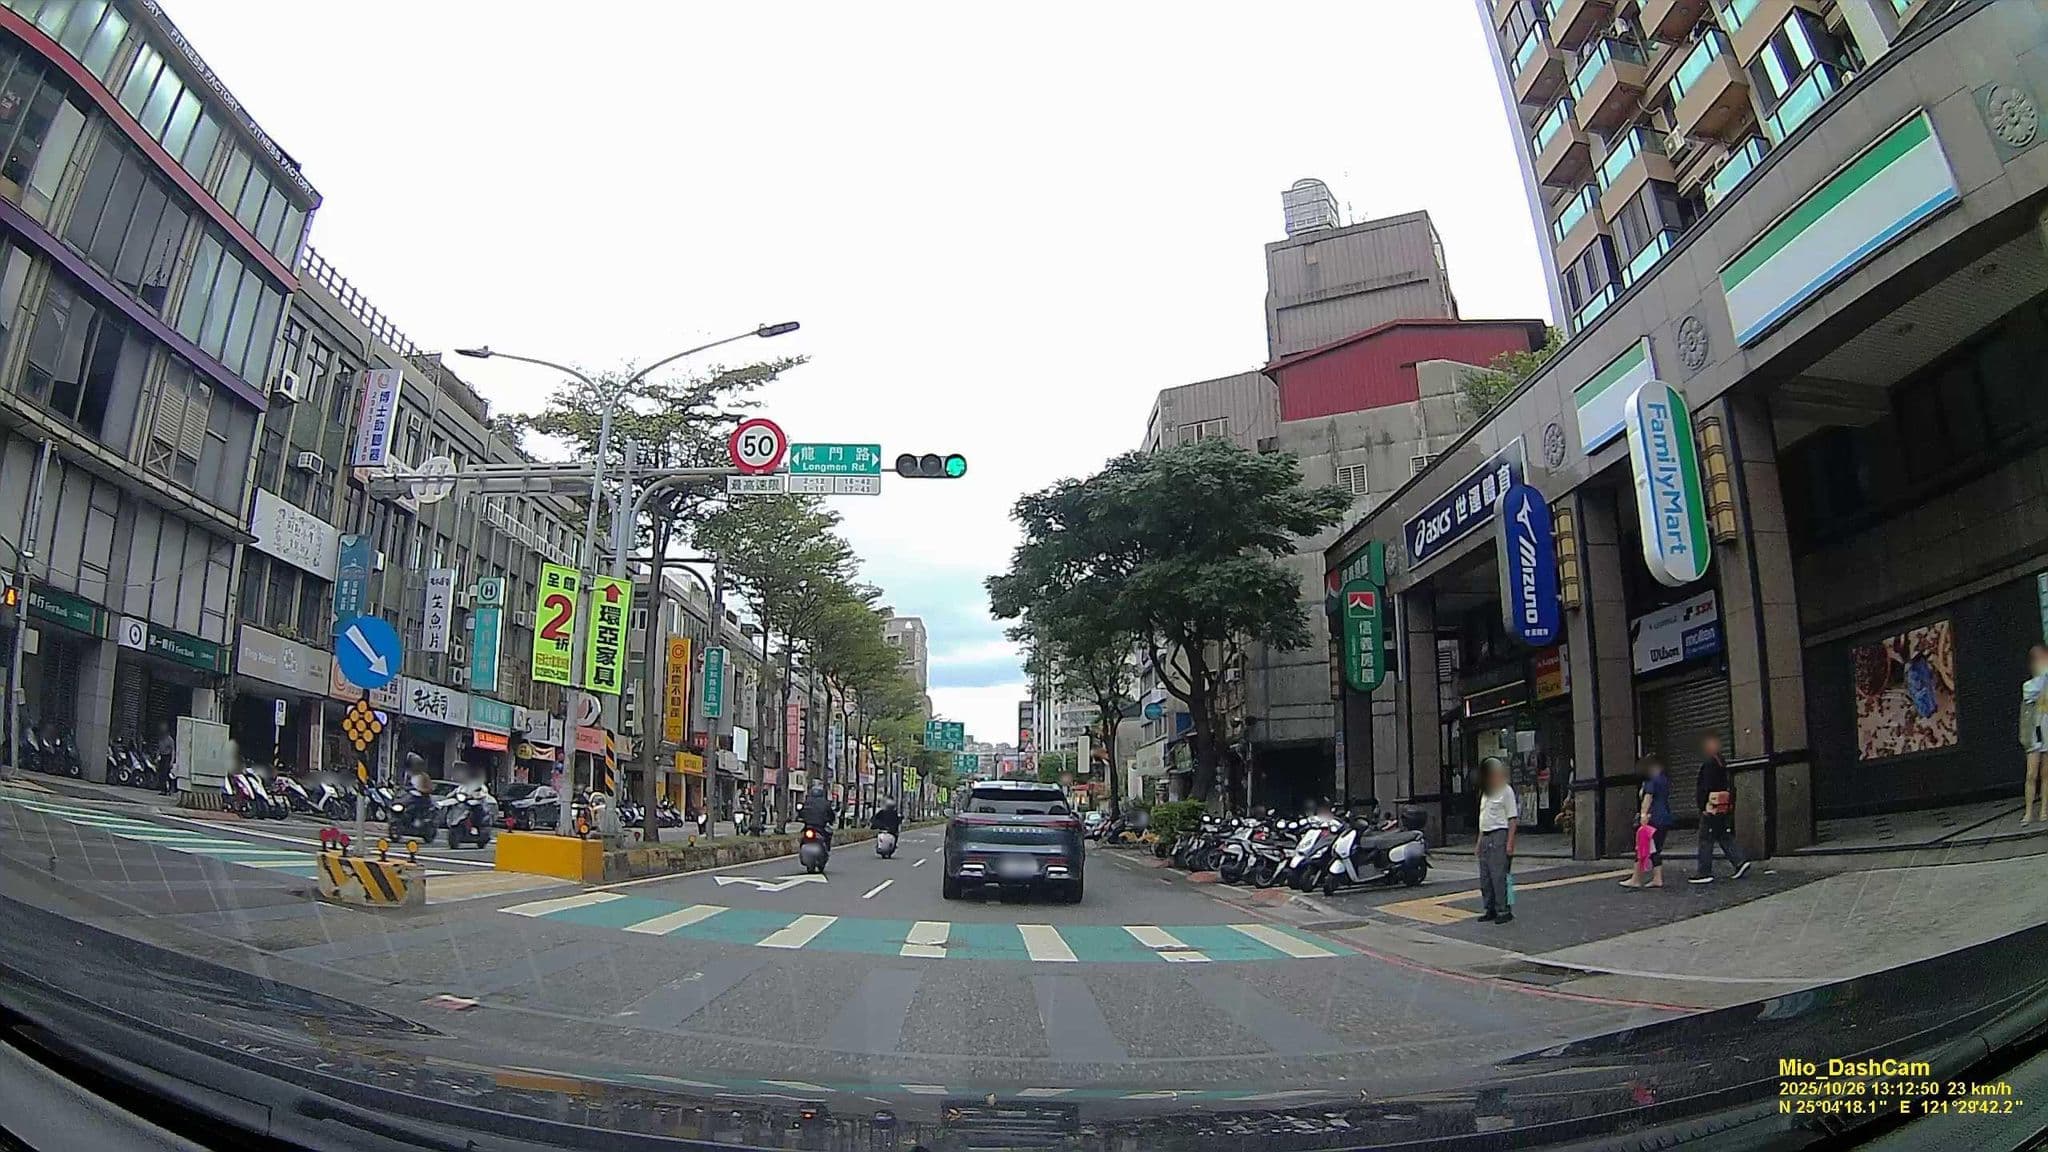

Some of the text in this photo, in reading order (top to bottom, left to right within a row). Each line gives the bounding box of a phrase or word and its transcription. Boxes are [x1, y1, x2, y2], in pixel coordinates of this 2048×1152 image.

[170, 28, 241, 112] FITNESS FACTORY
[249, 121, 315, 195] FITNESS FACTORY
[743, 435, 774, 457] 50
[801, 447, 871, 461] 龍門路
[851, 463, 868, 472] Rd.
[730, 479, 780, 491] 最高速限
[1648, 403, 1687, 555] FamilyMart
[428, 594, 444, 649] 生魚片
[540, 594, 573, 641] 2
[555, 638, 569, 652] 折
[593, 604, 622, 687] 環亞家具
[1359, 620, 1375, 683] 信義房屋
[1649, 646, 1680, 663] Wilson
